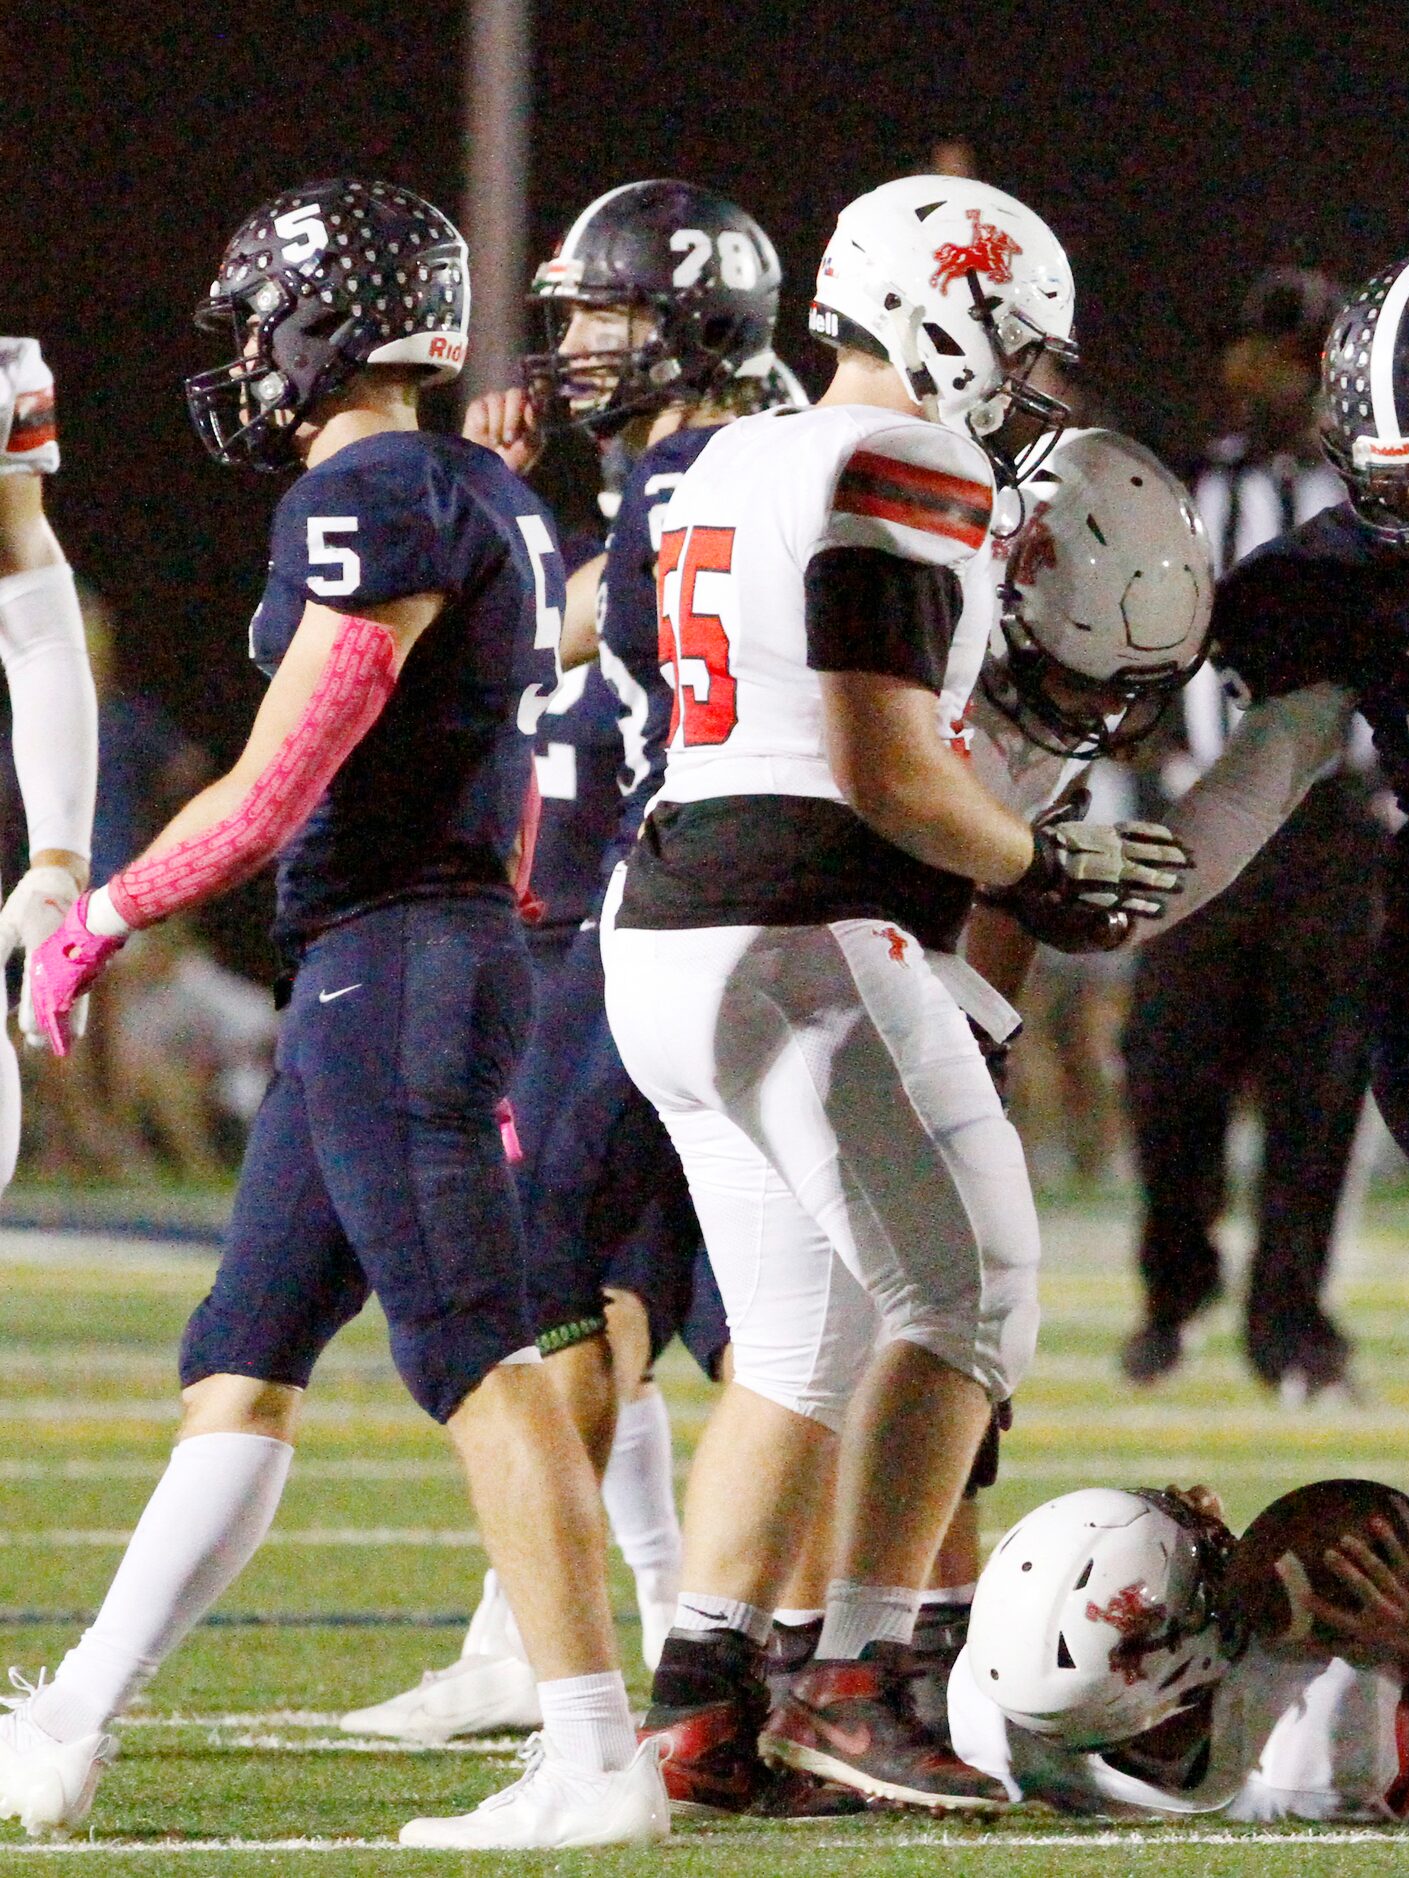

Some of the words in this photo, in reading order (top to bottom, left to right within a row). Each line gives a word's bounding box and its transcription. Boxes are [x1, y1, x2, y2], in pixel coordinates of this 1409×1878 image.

[274, 203, 329, 263] 5
[669, 229, 757, 290] 28
[306, 516, 361, 597] 5
[516, 514, 566, 736] 5
